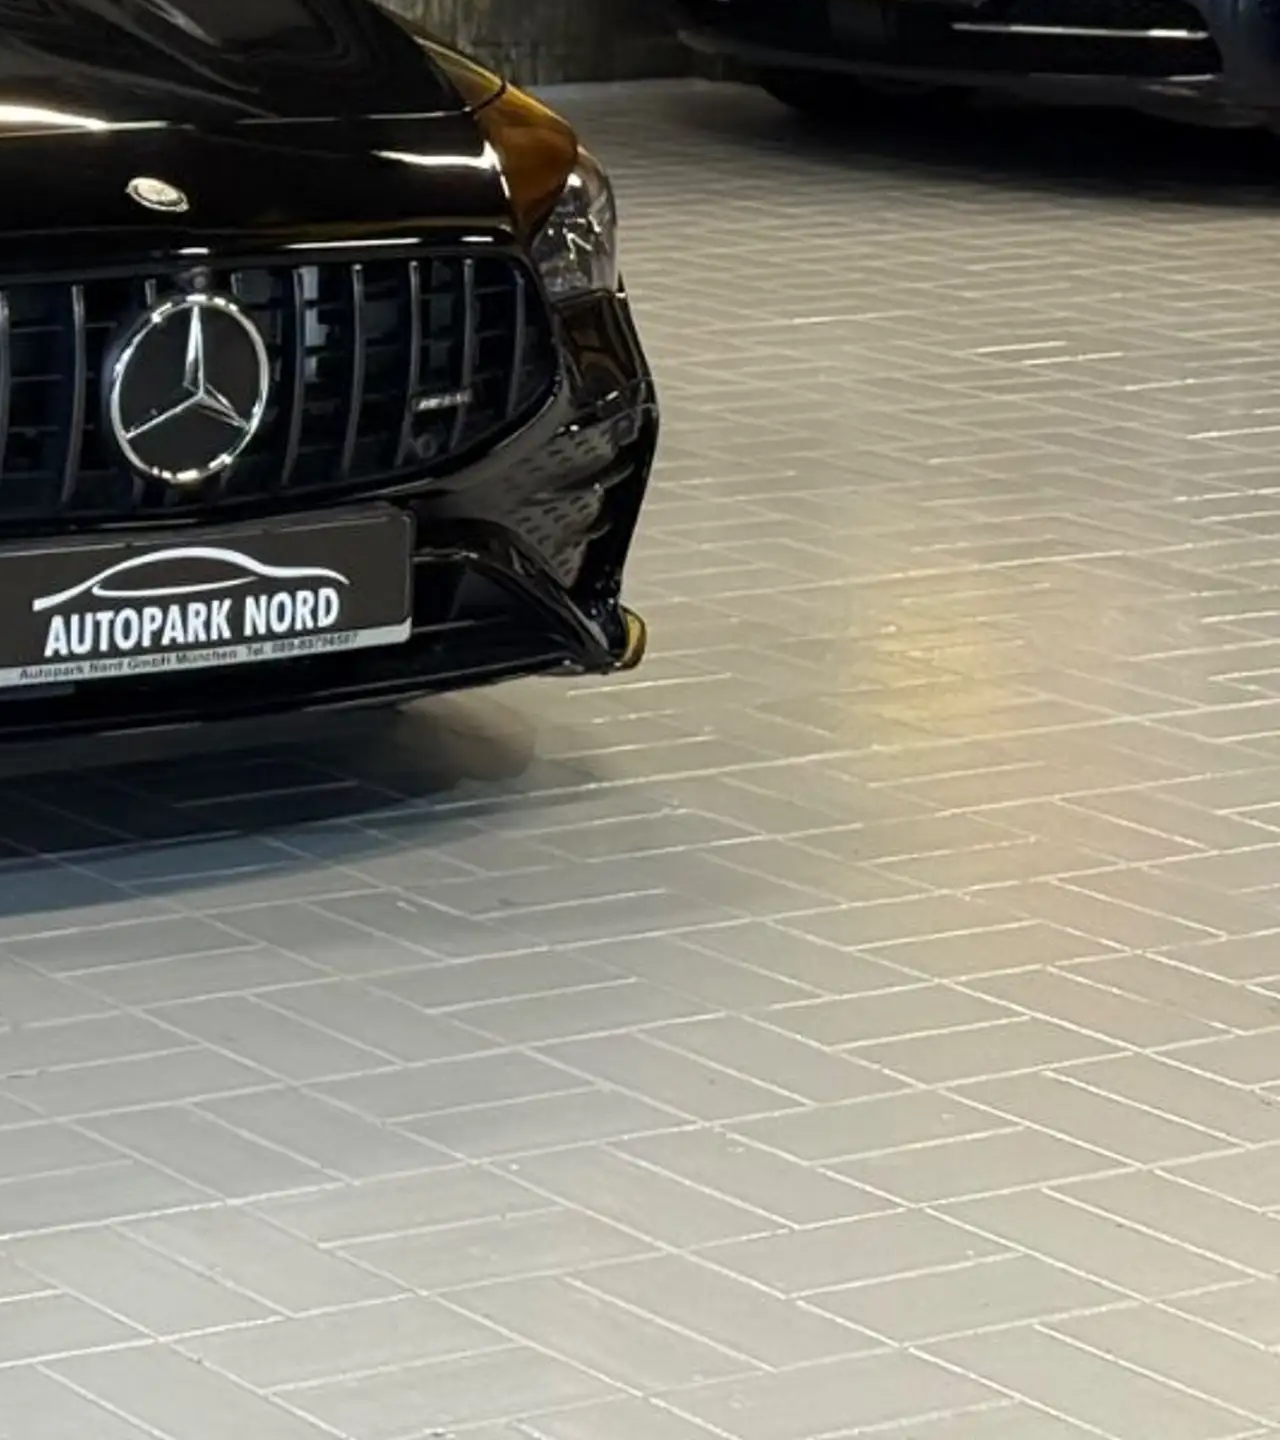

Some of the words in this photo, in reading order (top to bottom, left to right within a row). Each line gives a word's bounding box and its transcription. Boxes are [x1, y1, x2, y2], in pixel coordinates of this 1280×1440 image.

[43, 598, 234, 658] AUTOPARK
[242, 586, 340, 638] NORD
[19, 664, 85, 681] Autopark
[89, 660, 124, 675] Nord
